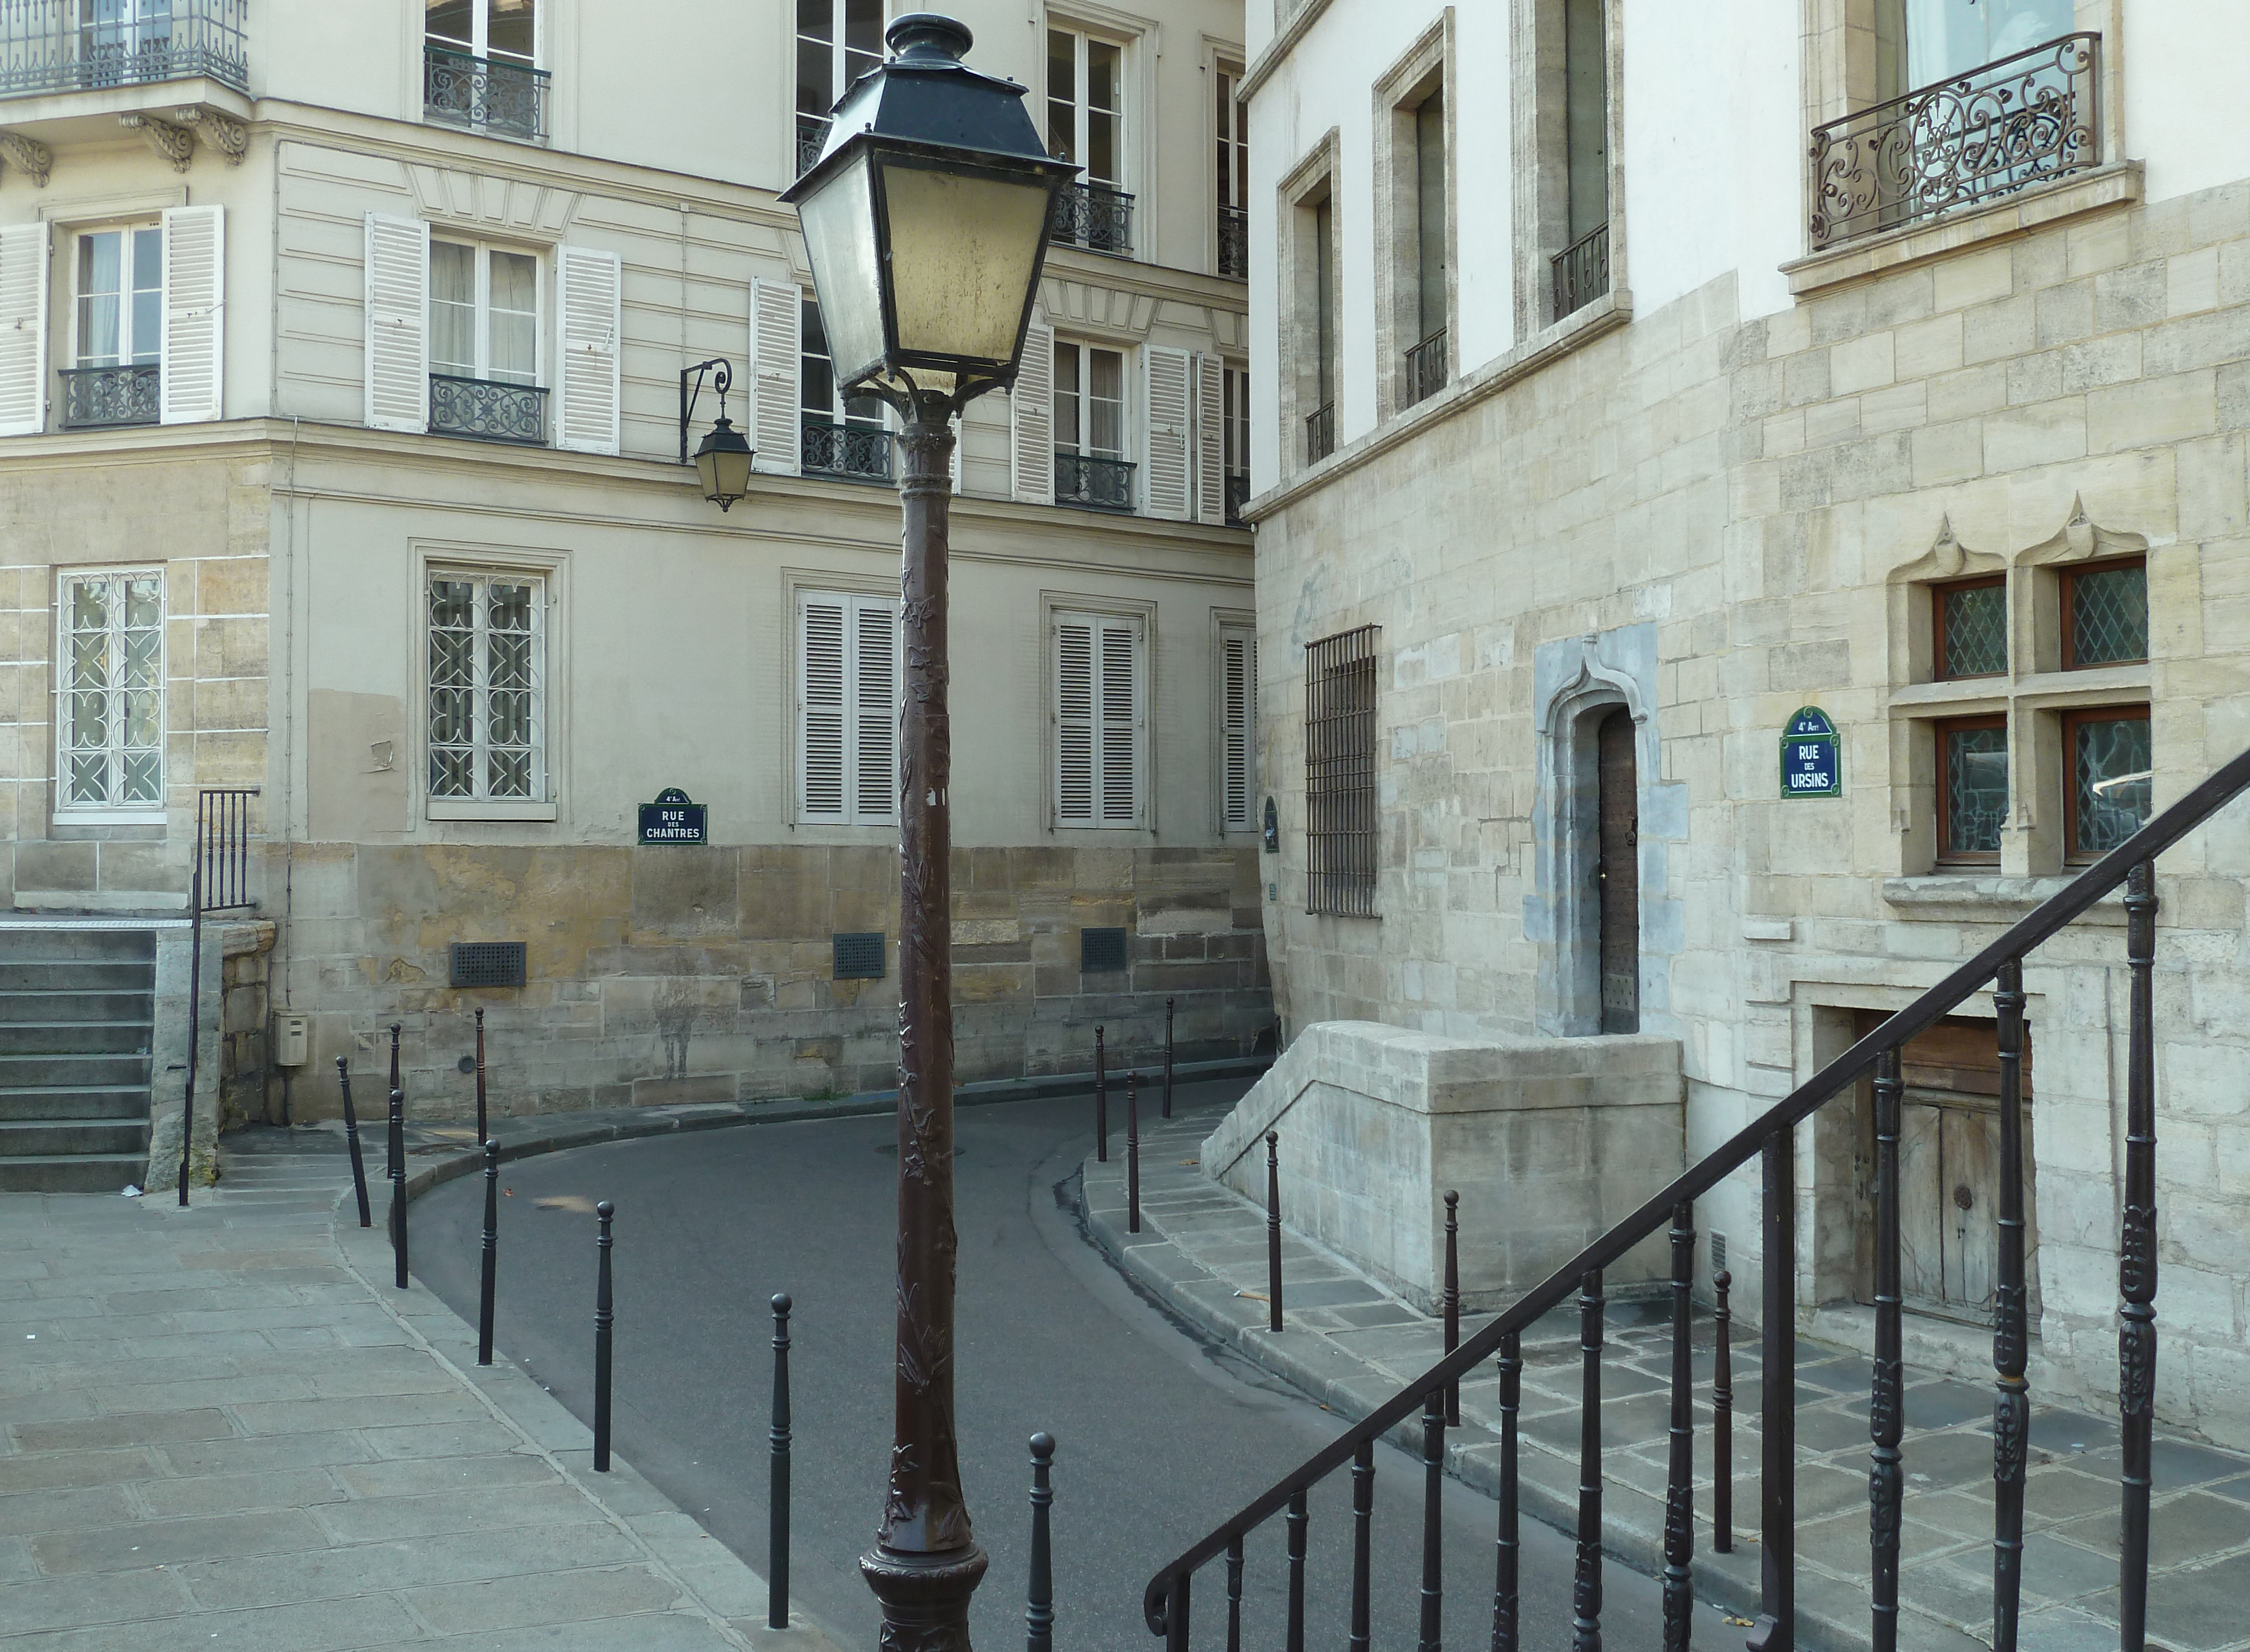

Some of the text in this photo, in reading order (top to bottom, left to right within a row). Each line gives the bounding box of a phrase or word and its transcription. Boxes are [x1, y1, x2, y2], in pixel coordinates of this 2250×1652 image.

[1799, 745, 1819, 760] RUE
[1791, 773, 1828, 788] URSINS
[662, 811, 684, 820] RUE
[647, 828, 699, 838] CHANTRES
